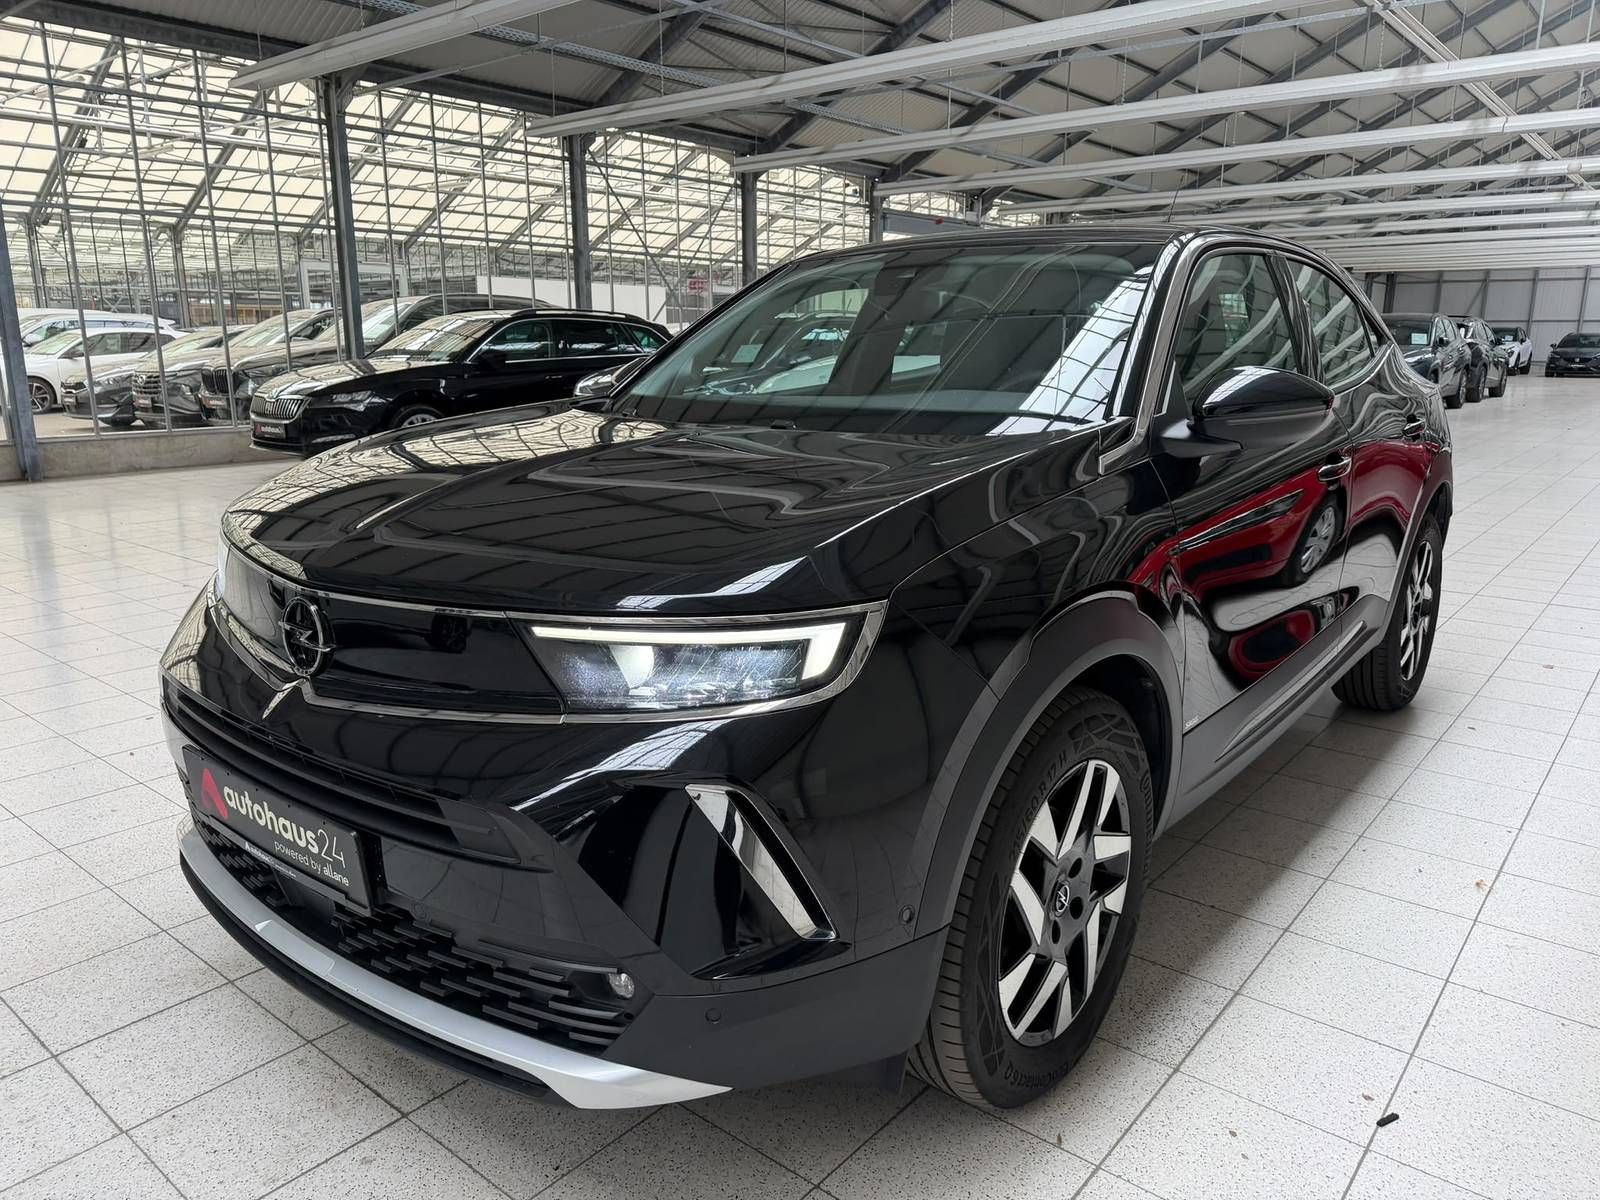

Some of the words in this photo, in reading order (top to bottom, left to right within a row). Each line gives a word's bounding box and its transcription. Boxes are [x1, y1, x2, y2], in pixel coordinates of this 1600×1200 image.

[223, 786, 346, 869] autohaus24
[274, 841, 309, 866] powered
[310, 856, 322, 875] by
[323, 863, 350, 887] allane
